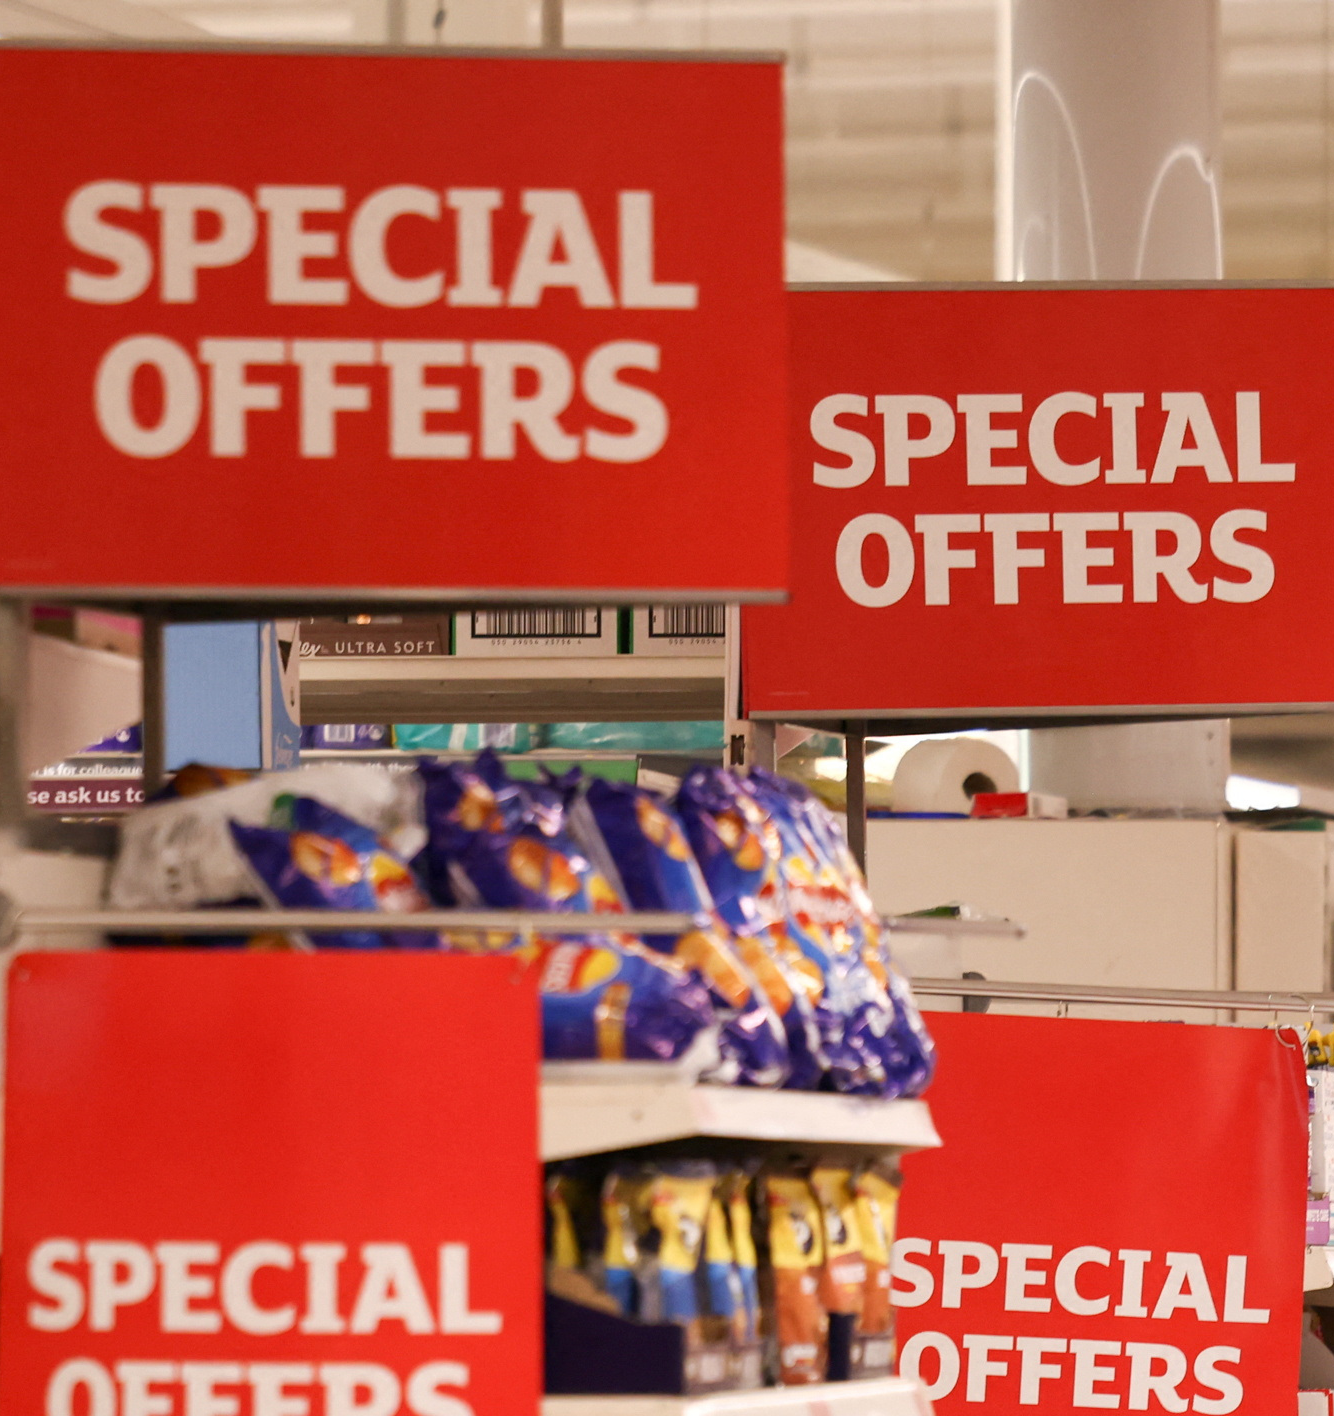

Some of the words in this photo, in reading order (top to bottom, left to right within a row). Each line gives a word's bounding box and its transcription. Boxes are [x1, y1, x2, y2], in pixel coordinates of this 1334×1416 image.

[63, 179, 699, 310] SPECIAL
[93, 334, 670, 465] OFFERS
[809, 390, 1296, 489] SPECIAL
[835, 508, 1276, 608] OFFERS
[335, 641, 386, 654] ULTRA
[394, 641, 435, 654] SOFT
[54, 786, 91, 804] ask
[96, 790, 121, 803] us
[26, 1237, 504, 1336] SPECIAL
[891, 1237, 1271, 1324] SPECIAL
[899, 1330, 1244, 1416] OFFERS
